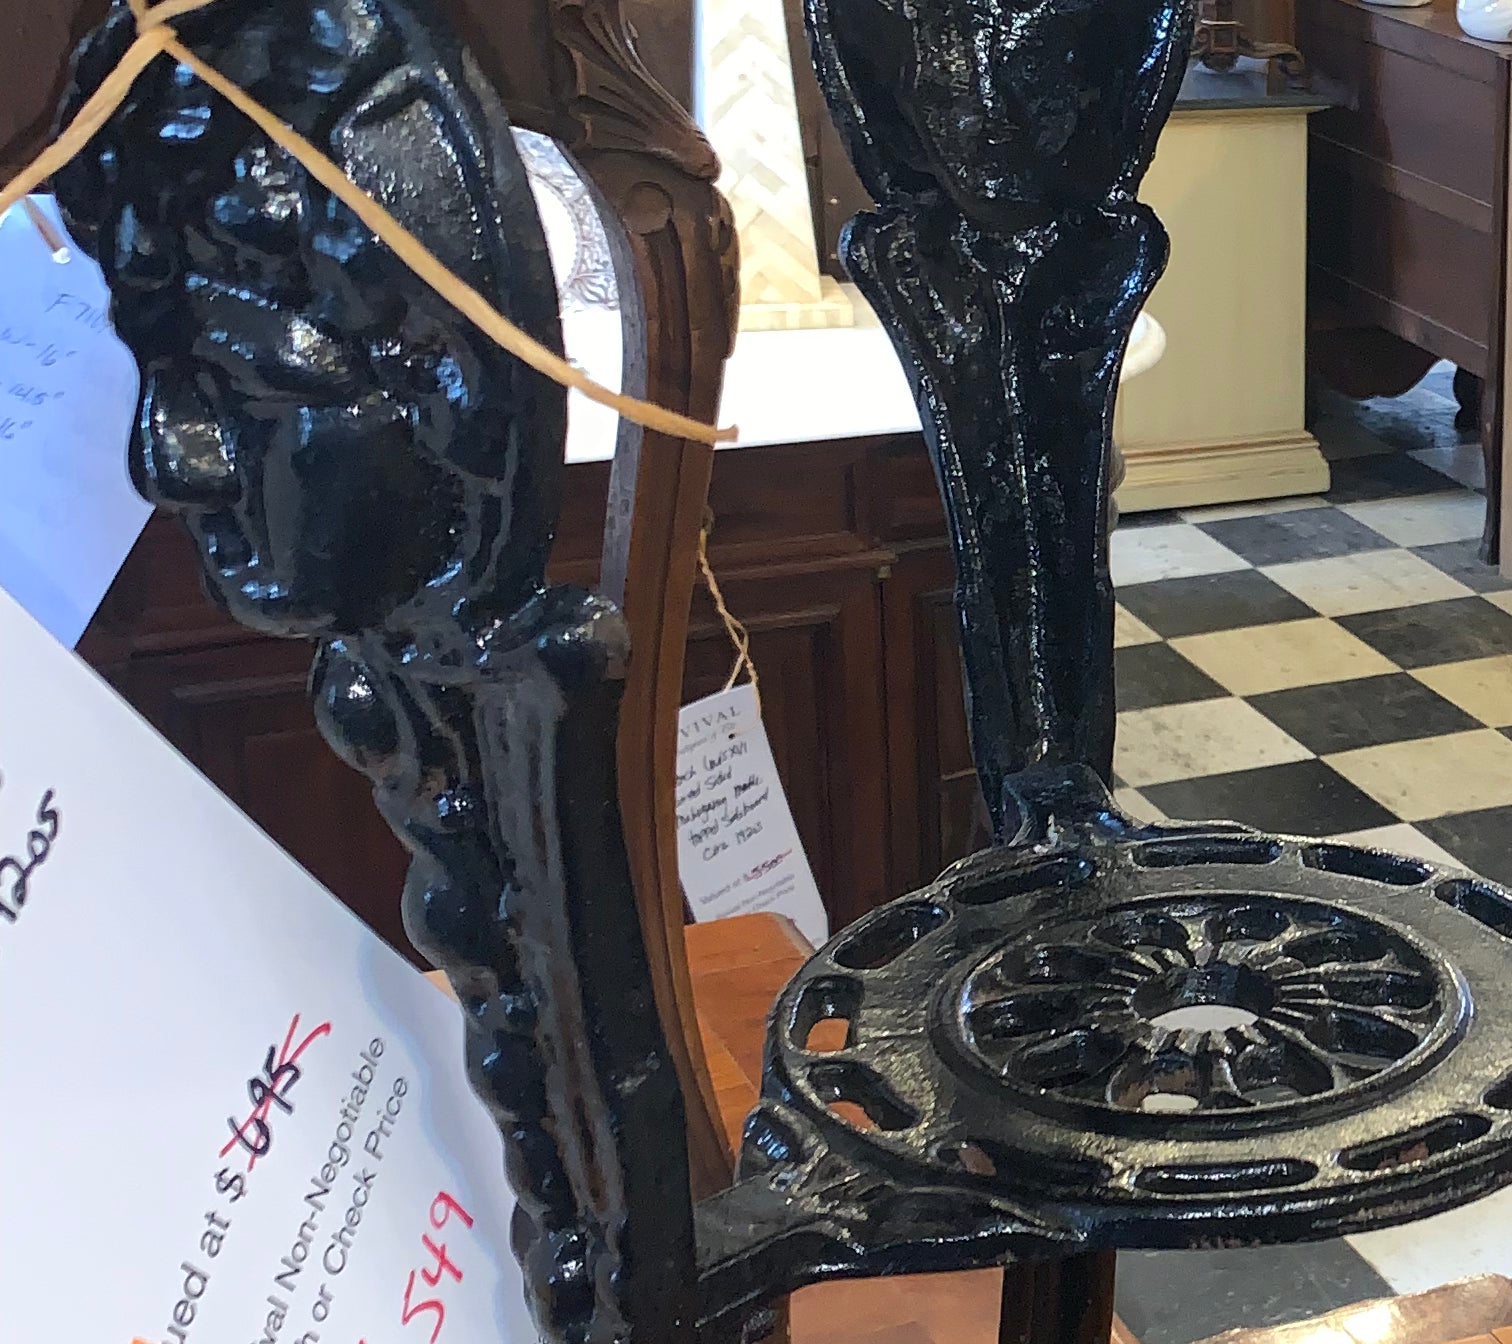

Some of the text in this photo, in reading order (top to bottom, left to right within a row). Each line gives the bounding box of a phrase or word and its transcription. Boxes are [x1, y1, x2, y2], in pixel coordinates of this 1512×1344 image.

[679, 704, 742, 738] VIVAL
[363, 1074, 410, 1162] Price
[213, 1166, 247, 1204] $
[274, 1035, 386, 1293] Non-Negotiable
[199, 1208, 232, 1259] at
[322, 1166, 379, 1277] Check
[311, 1282, 335, 1325] or
